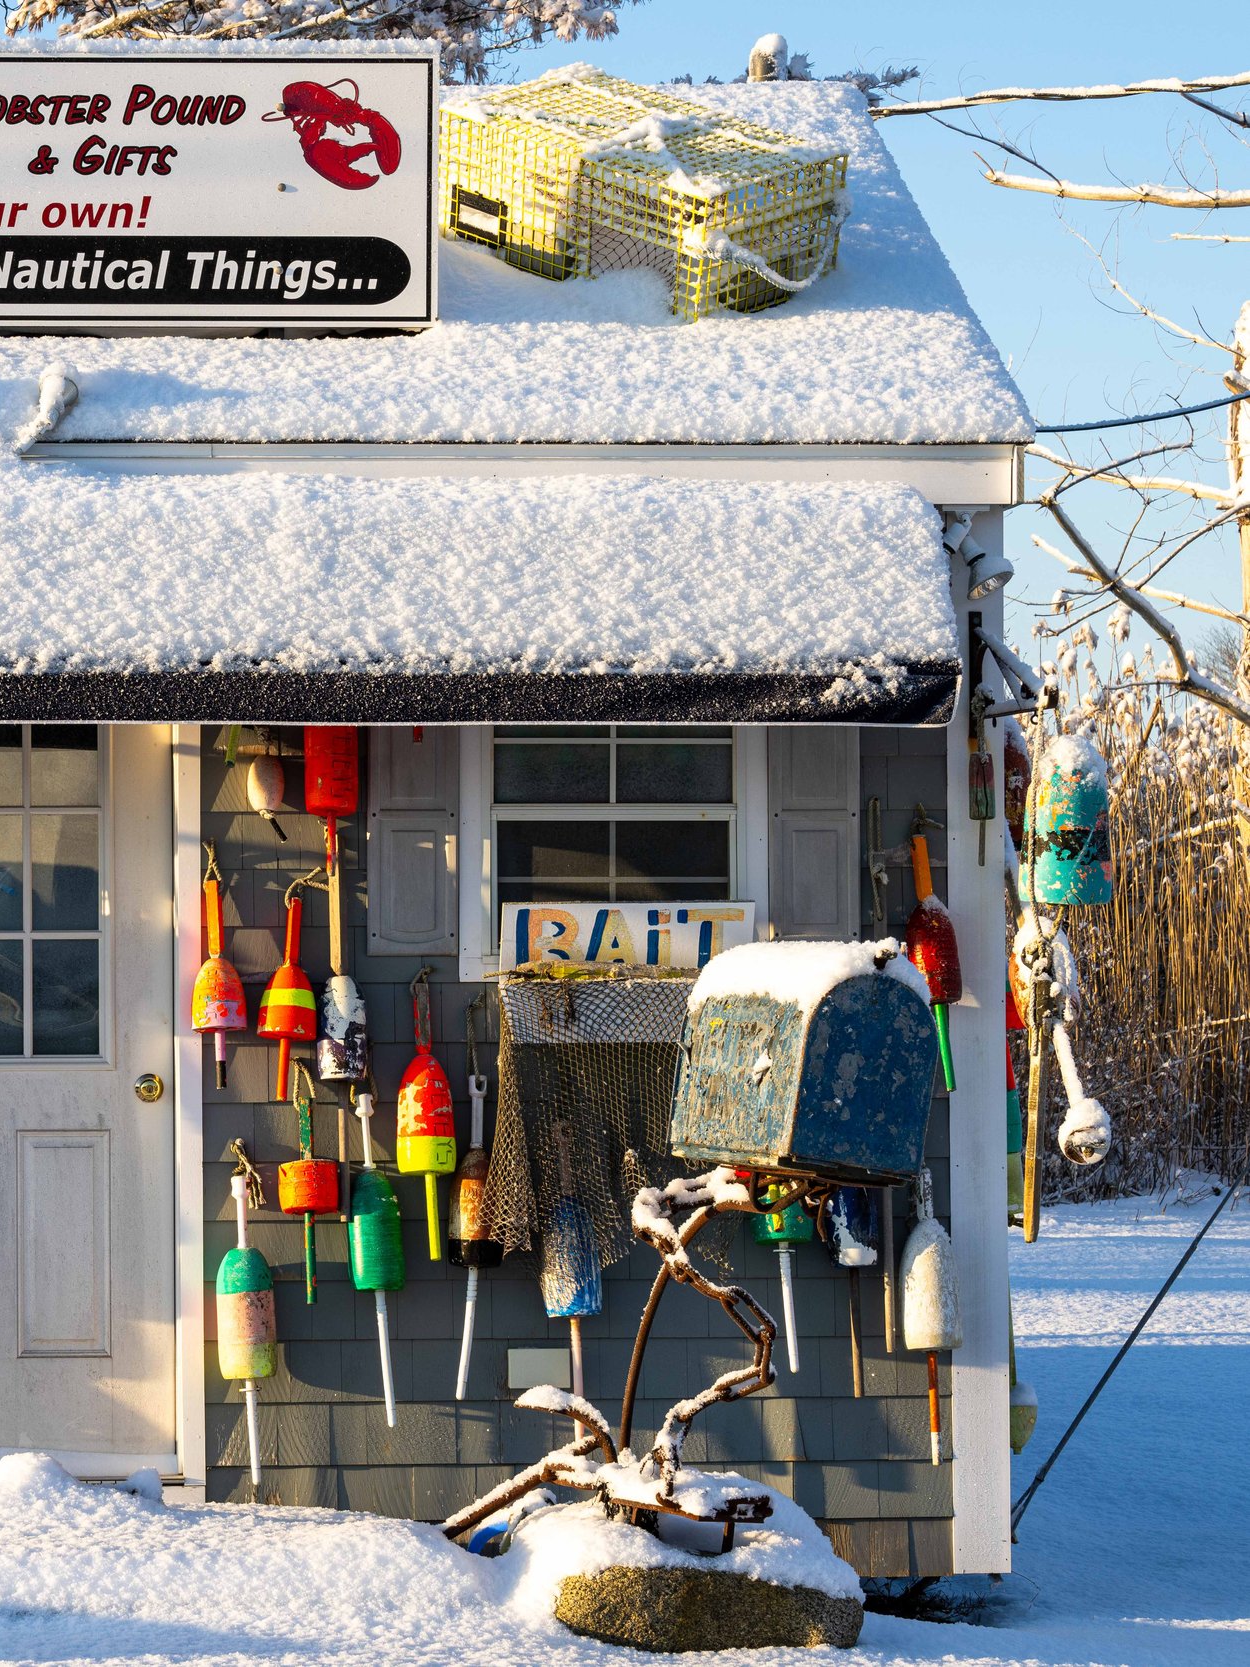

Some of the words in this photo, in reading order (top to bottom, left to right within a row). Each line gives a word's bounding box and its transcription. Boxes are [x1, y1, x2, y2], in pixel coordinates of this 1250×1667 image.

[122, 84, 246, 125] POUND
[27, 144, 59, 175] &
[73, 135, 177, 176] GIFTS
[40, 195, 152, 229] own!
[186, 250, 379, 299] Things...
